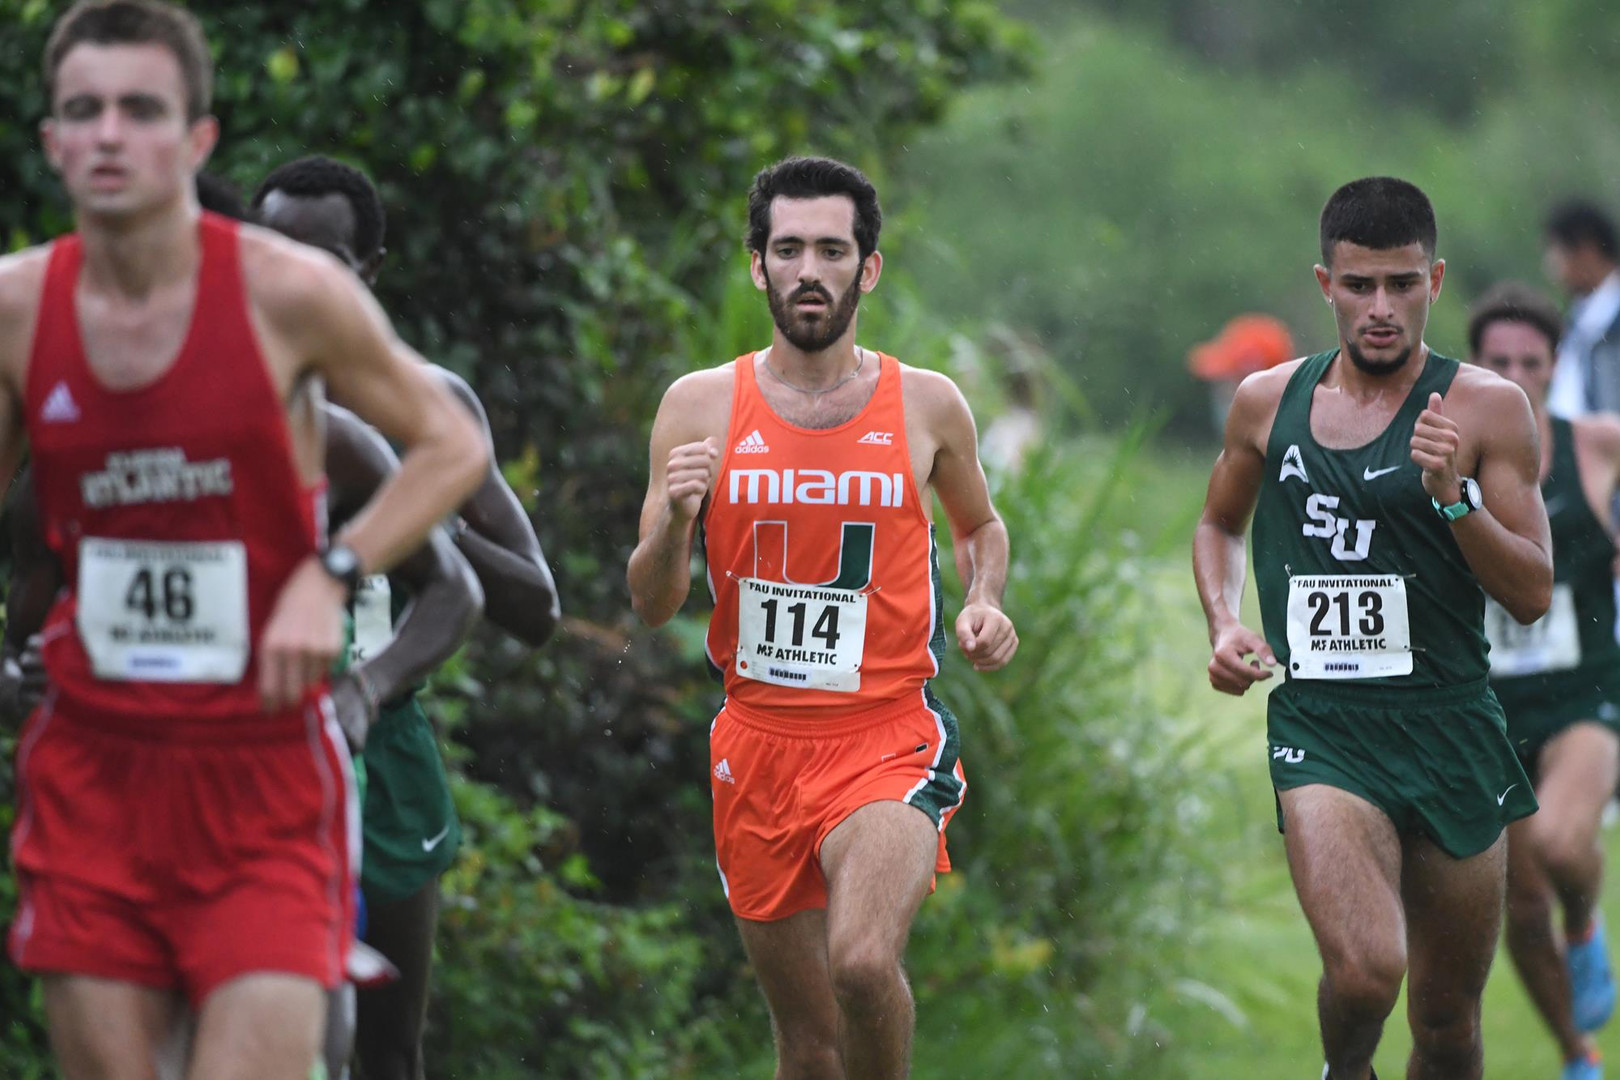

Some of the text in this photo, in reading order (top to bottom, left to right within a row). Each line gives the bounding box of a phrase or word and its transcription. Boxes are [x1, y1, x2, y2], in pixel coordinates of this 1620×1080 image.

[861, 431, 894, 443] ACC
[735, 444, 769, 454] adidas
[1303, 493, 1376, 561] SU
[749, 581, 856, 604] FAU INVITATIONAL
[1297, 578, 1394, 588] FAU INVITATIONAL
[125, 567, 193, 622] 46
[1308, 591, 1384, 636] 213
[761, 599, 840, 650] 114
[1329, 638, 1387, 652] ATHLETIC
[775, 648, 837, 666] ATHLETIC
